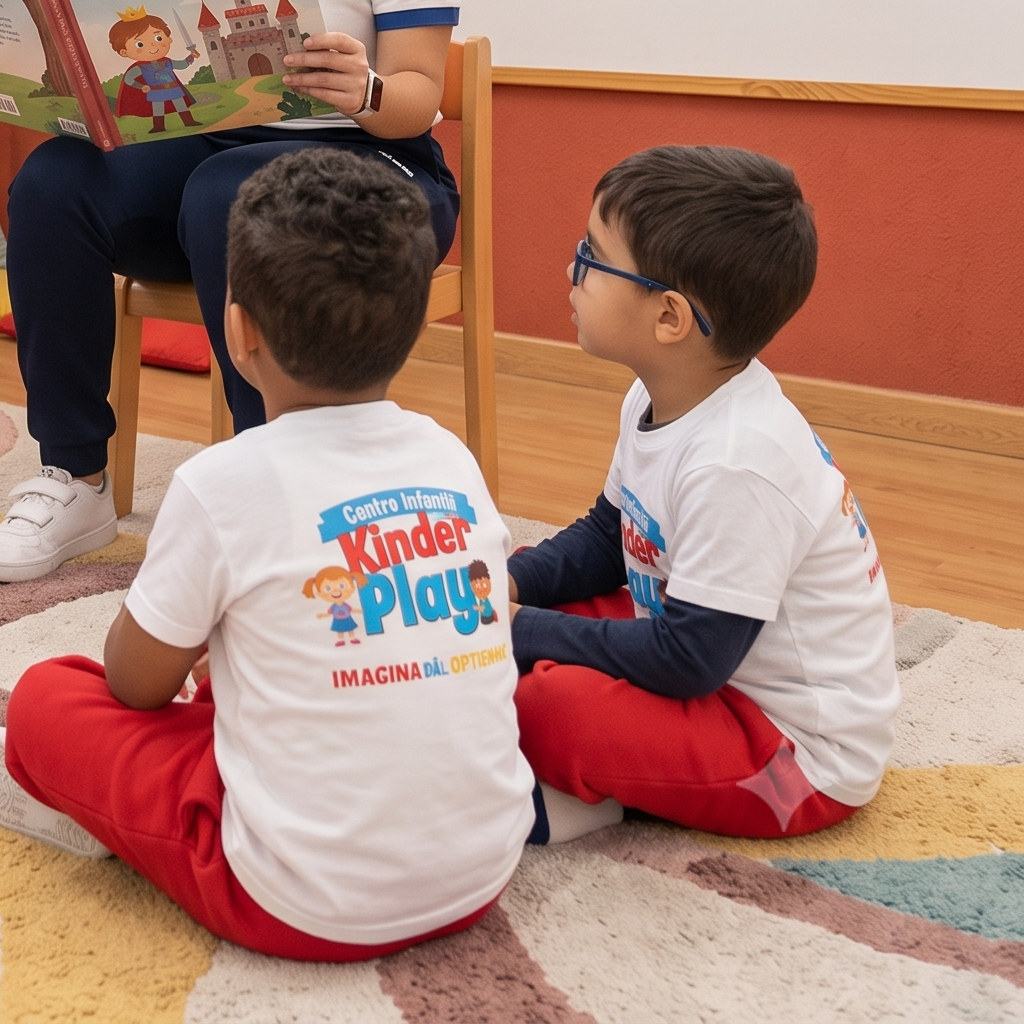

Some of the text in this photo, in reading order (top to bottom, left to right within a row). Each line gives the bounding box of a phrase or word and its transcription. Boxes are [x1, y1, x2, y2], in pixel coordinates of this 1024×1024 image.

[342, 497, 399, 525] Centro
[337, 511, 472, 575] Kinder
[357, 564, 480, 636] Play
[332, 662, 423, 689] IMAGINA
